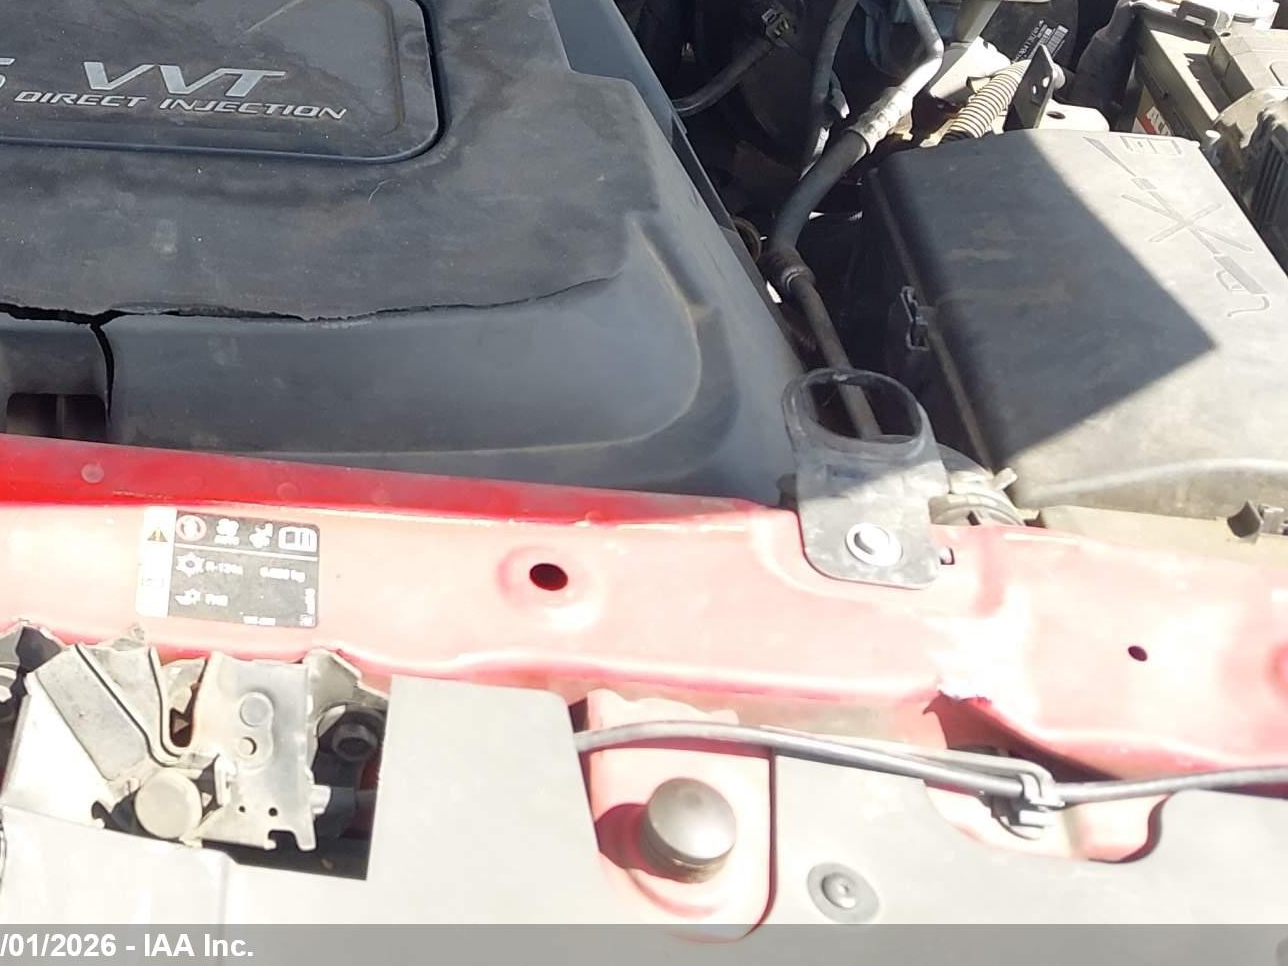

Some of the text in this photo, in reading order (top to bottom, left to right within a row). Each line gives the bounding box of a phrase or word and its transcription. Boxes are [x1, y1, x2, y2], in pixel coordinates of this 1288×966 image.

[82, 61, 286, 96] VVT
[13, 90, 347, 121] DIRECT INJECTION
